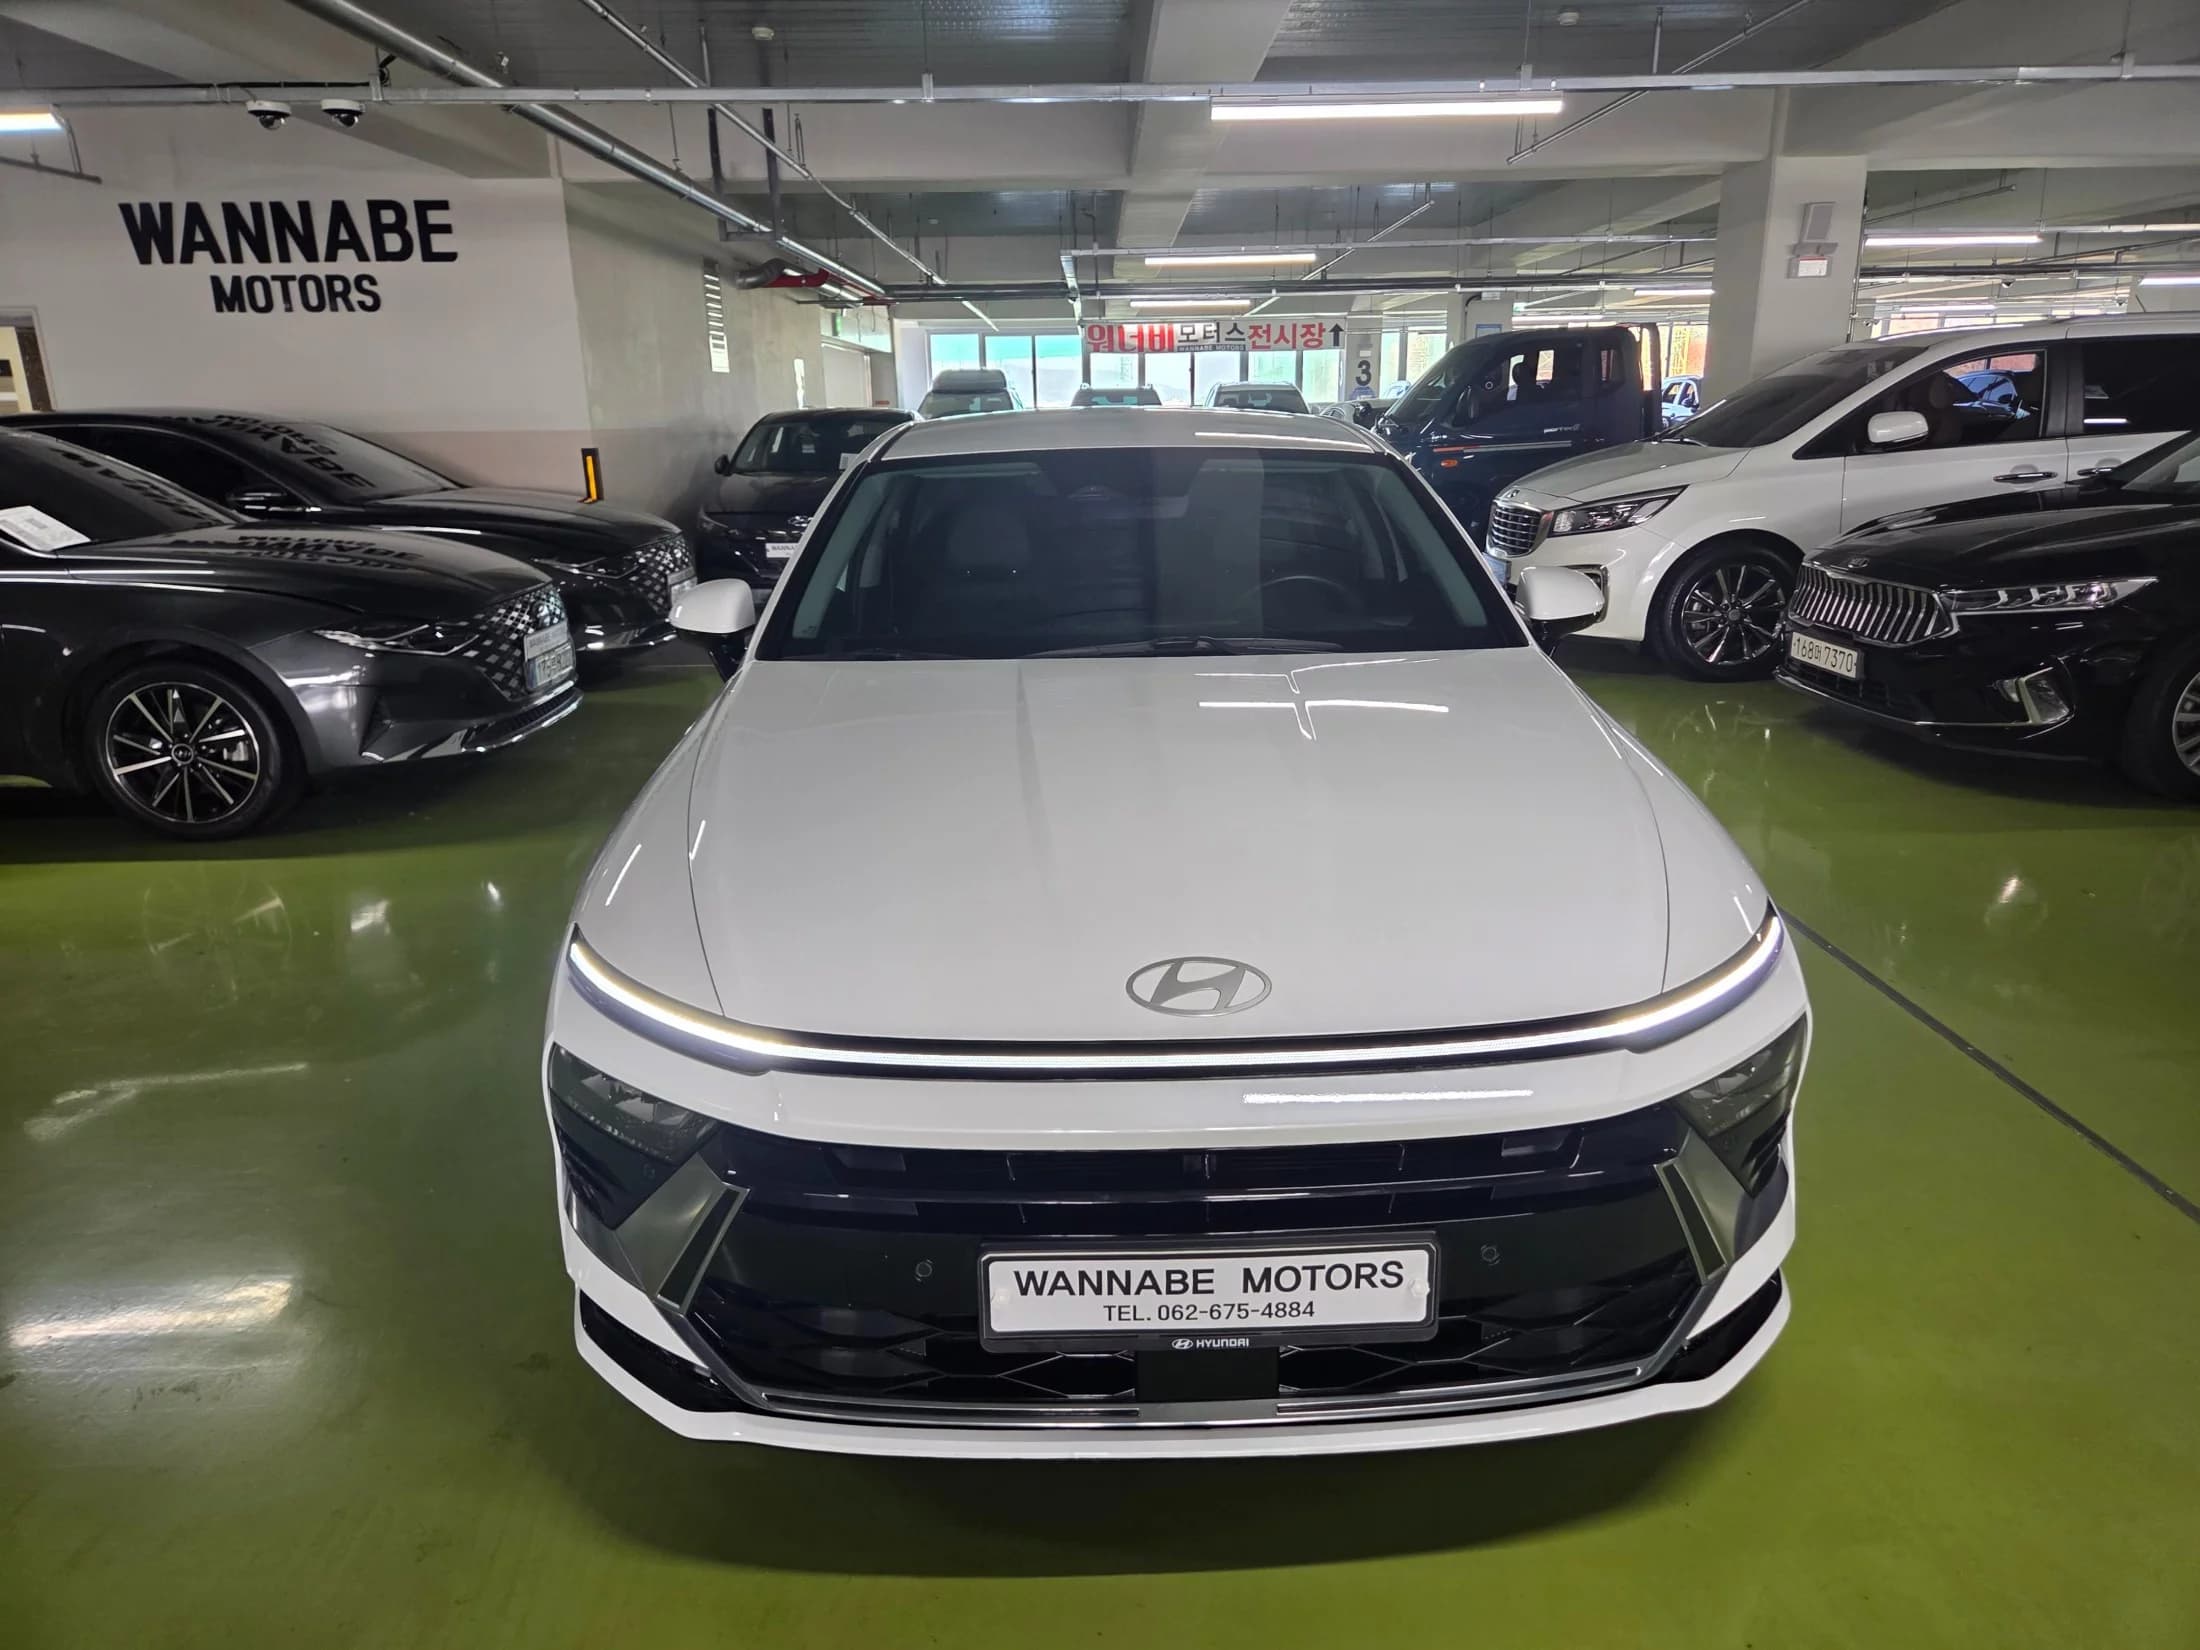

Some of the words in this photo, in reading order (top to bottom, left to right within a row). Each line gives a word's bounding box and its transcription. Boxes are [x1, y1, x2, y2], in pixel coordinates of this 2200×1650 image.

[118, 199, 458, 265] WANNABE
[210, 274, 381, 313] MOTORS
[1355, 360, 1372, 386] 3
[1015, 1268, 1215, 1296] WANNABE
[1242, 1260, 1404, 1293] MOTORS
[1103, 1305, 1152, 1322] TEL.
[1157, 1300, 1315, 1321] 062-675-4884
[1196, 1337, 1250, 1348] HYUNDAI
